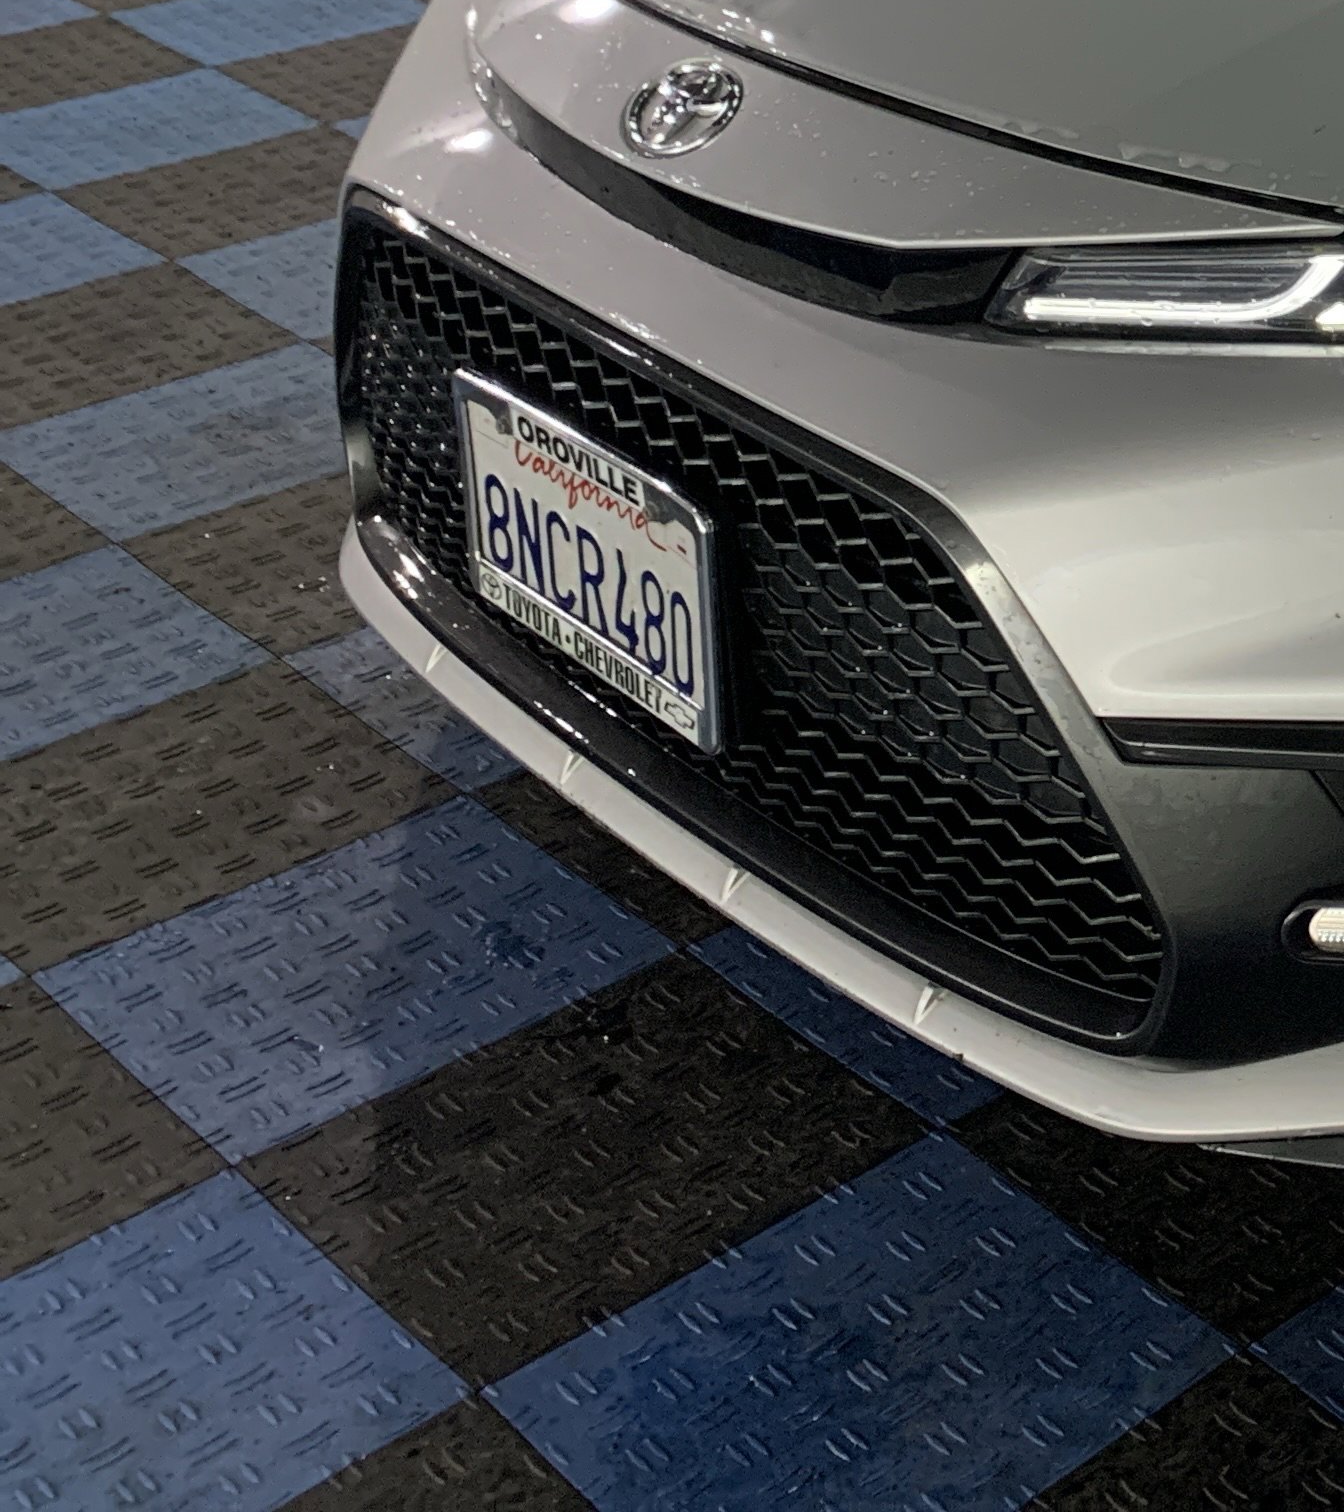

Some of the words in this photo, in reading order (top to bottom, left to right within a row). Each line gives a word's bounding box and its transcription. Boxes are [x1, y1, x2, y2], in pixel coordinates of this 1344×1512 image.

[517, 416, 640, 506] OROVILLE
[483, 473, 696, 699] 8NCR480
[502, 583, 562, 646] TOYOTA
[574, 630, 662, 714] CHEVROLET
